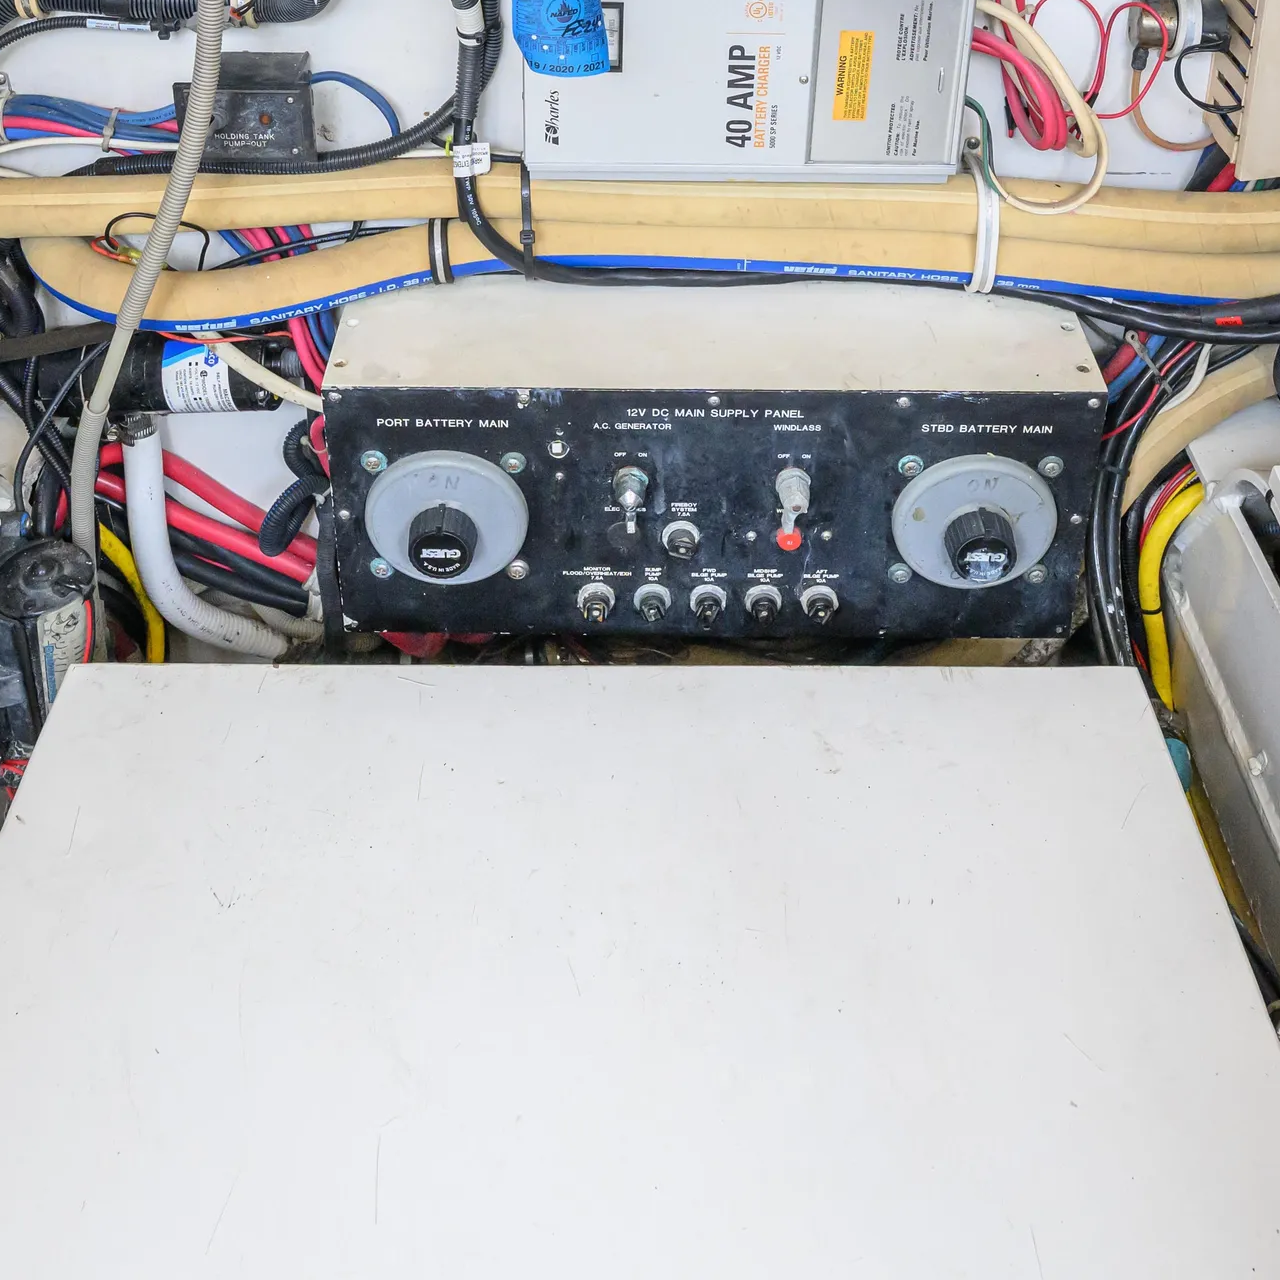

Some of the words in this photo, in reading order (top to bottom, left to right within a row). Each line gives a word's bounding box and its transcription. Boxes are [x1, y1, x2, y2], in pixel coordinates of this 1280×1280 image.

[901, 25, 909, 60] L'EXPLOSION.
[909, 13, 918, 61] ADVERTISSEMENT:
[924, 22, 932, 48] Utilisation
[549, 64, 574, 73] 2020
[584, 61, 605, 72] 2021
[726, 44, 756, 111] AMP
[756, 45, 771, 97] CHARGER
[836, 55, 847, 96] WARNING
[754, 100, 767, 148] BATTERY
[770, 104, 778, 126] SERIES
[888, 102, 896, 133] PROTECTED.
[725, 120, 752, 148] 40
[770, 127, 777, 135] SP
[848, 269, 915, 280] SANITARY
[921, 274, 958, 283] HOSE
[250, 304, 323, 325] SANITARY
[329, 291, 367, 307] HOSE
[379, 284, 400, 294] I.D.
[376, 418, 412, 428] PORT
[415, 418, 473, 428] BATTERY
[479, 418, 509, 428] MAIN
[626, 408, 647, 417] 12V
[651, 409, 669, 417] DC
[674, 408, 705, 417] MAIN
[710, 408, 759, 419] SUPPLY
[764, 409, 804, 419] PANEL
[593, 422, 611, 430] A.C.
[614, 422, 672, 430] GENERATOR
[773, 424, 821, 432] WINDLASS
[921, 424, 955, 433] STBD
[959, 424, 1018, 434] BATTERY
[1022, 425, 1053, 434] MAIN
[421, 548, 462, 559] GUEST
